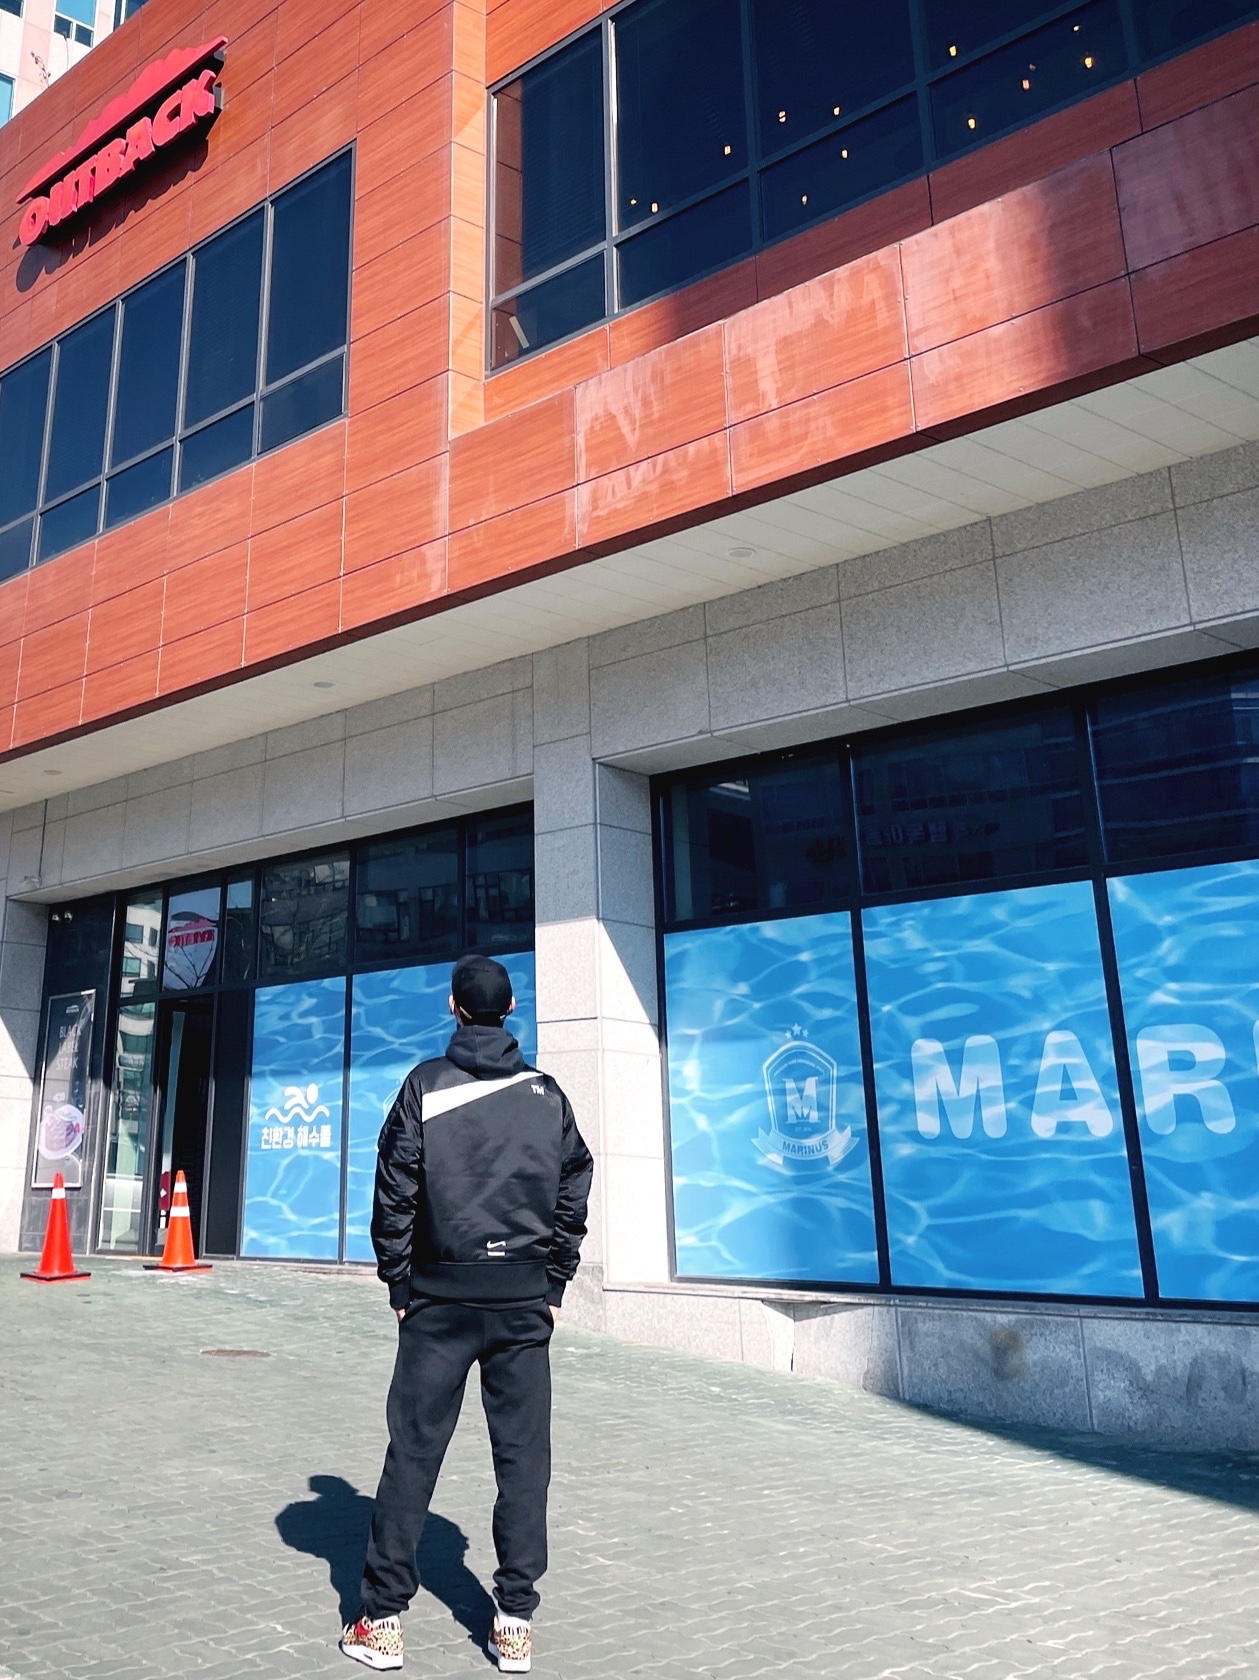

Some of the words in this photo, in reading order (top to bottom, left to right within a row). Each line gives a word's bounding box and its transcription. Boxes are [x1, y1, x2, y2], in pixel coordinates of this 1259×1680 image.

[19, 69, 216, 247] OUTBACK
[56, 1057, 78, 1071] STEAK
[911, 1019, 1259, 1139] MAR
[530, 1084, 545, 1096] TM
[261, 1126, 295, 1149] 친환경
[782, 1140, 829, 1156] MARINUS
